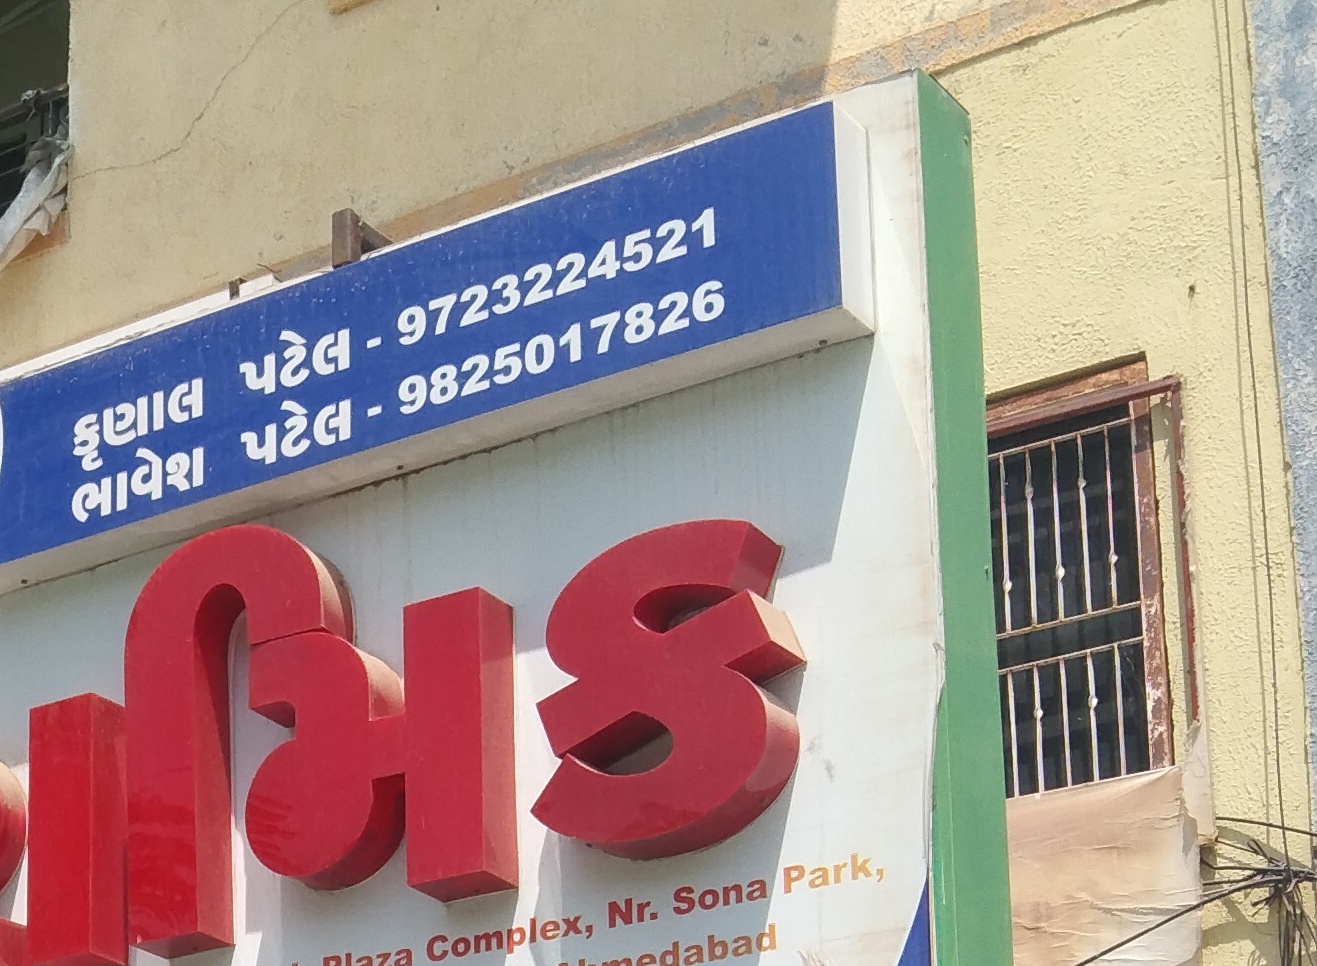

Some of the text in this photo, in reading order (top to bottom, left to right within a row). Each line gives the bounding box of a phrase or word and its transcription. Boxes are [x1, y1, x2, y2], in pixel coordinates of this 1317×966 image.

[71, 446, 204, 523] ભાવેશ
[240, 399, 352, 465] પટેલ
[398, 280, 726, 415] 9825017826
[72, 378, 203, 471] કૃણાલ
[239, 329, 350, 394] પટેલ
[397, 207, 717, 347] 9723224521
[425, 914, 595, 965] Complex,
[606, 894, 659, 930] Nr.
[672, 876, 769, 918] Sona
[781, 853, 887, 896] Park,
